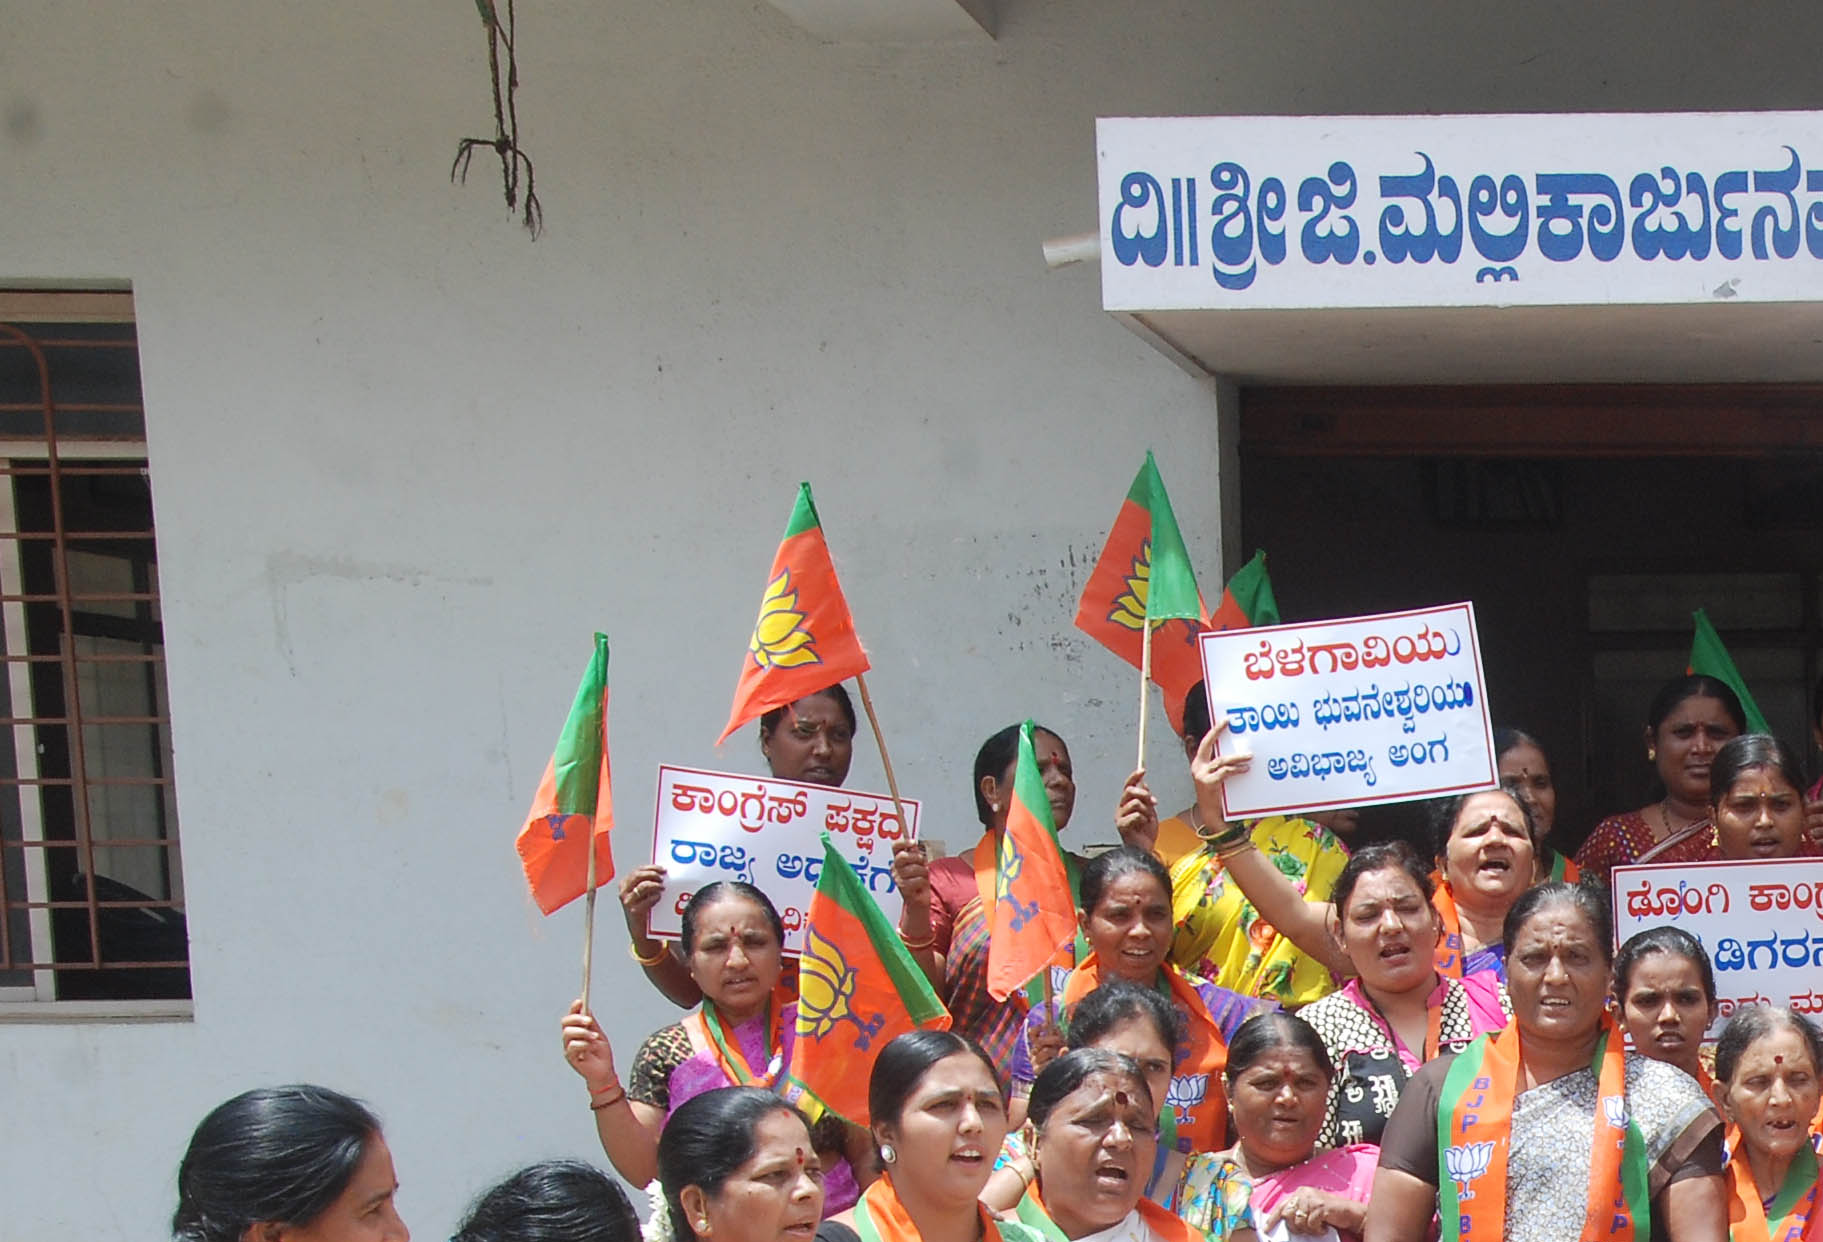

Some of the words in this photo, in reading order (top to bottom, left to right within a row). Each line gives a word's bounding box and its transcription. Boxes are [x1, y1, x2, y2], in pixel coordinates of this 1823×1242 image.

[1226, 699, 1300, 735] ತಾಯಿ
[1267, 748, 1378, 787] ಅವಿಭಾಜ್ಯ
[1388, 731, 1450, 768] ಅಂಗ
[671, 782, 808, 833] ಕಾಂಗ್ರೆಸ್
[825, 799, 904, 855] ಪಕ್ಷದ
[670, 838, 756, 884] ರಾಜ್ಯ
[1461, 1077, 1490, 1134] BJP
